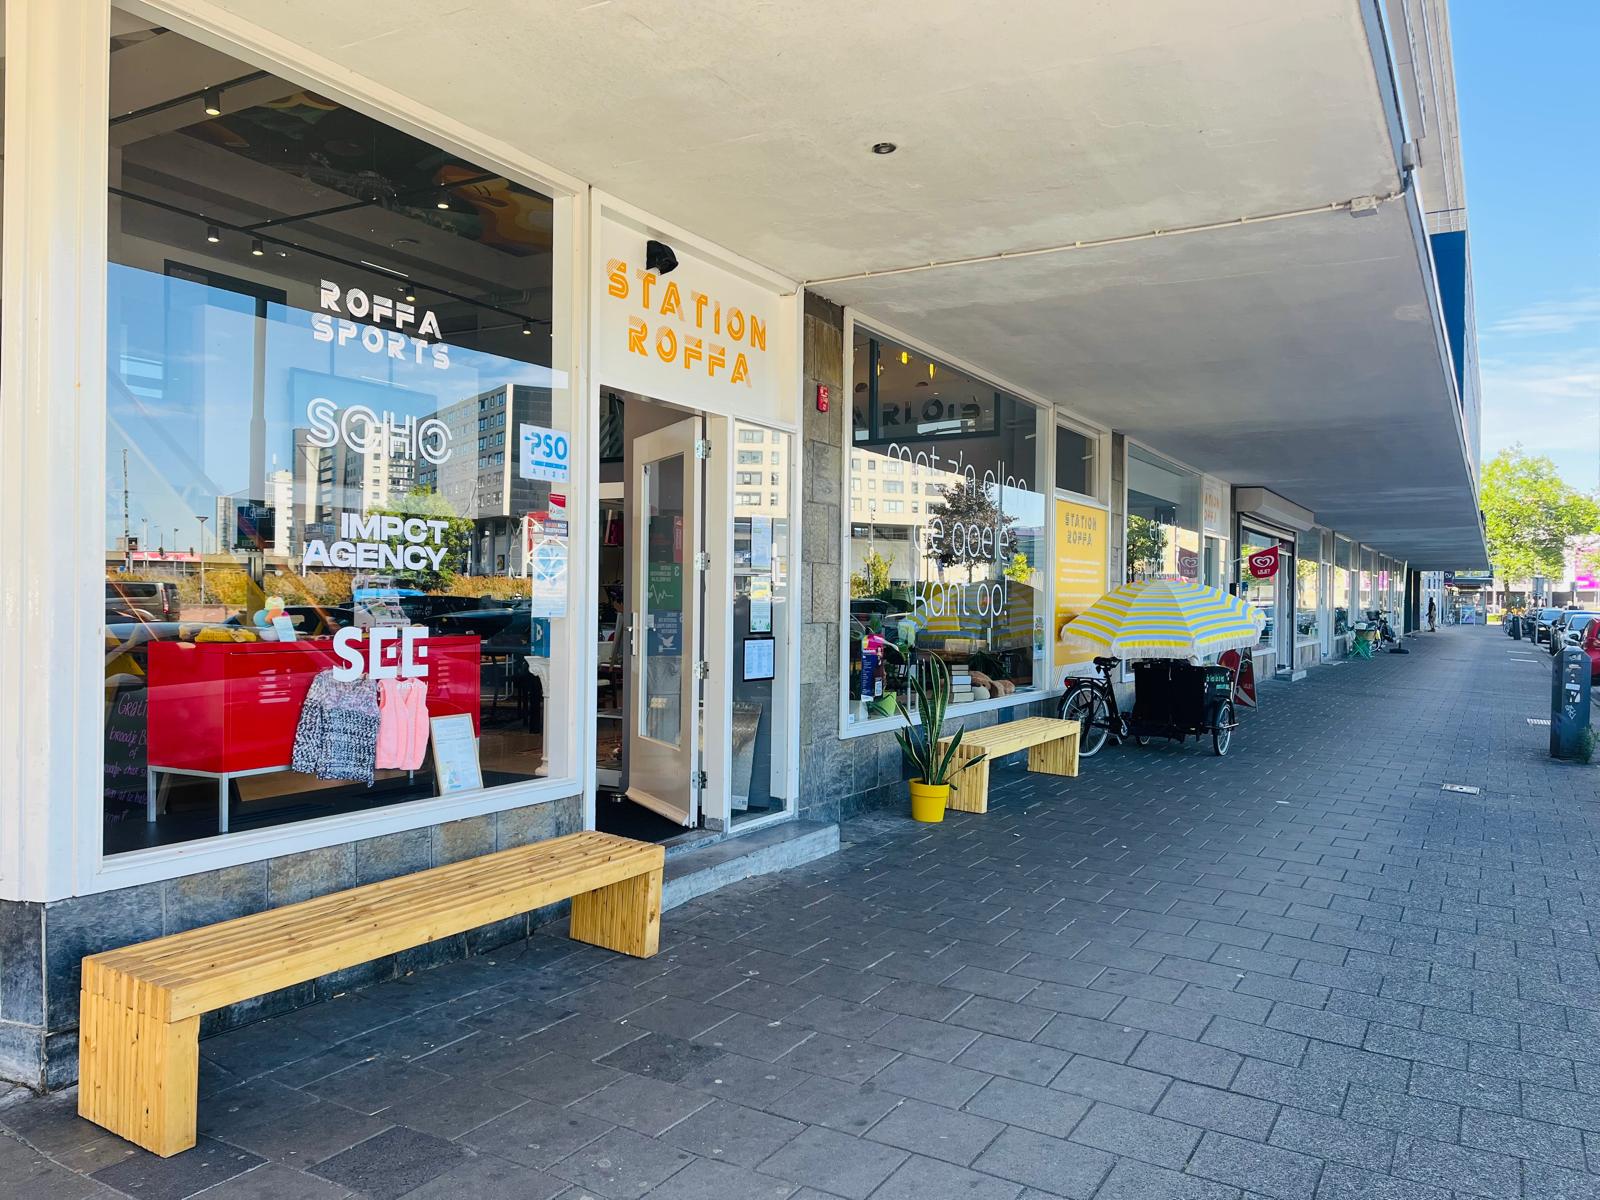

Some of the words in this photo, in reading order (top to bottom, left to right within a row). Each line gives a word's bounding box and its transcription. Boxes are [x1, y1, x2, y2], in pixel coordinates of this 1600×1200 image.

[320, 279, 442, 340] ROFFA
[606, 256, 767, 352] STATION
[311, 312, 450, 370] SPORTS
[628, 314, 752, 388] ROFFA
[306, 397, 453, 465] SOHO
[526, 431, 568, 460] PSO
[340, 512, 449, 545] IMPCT
[1065, 512, 1097, 531] STATION
[1066, 529, 1094, 546] ROFFA
[303, 539, 449, 571] AGENCY
[332, 625, 429, 683] SEE
